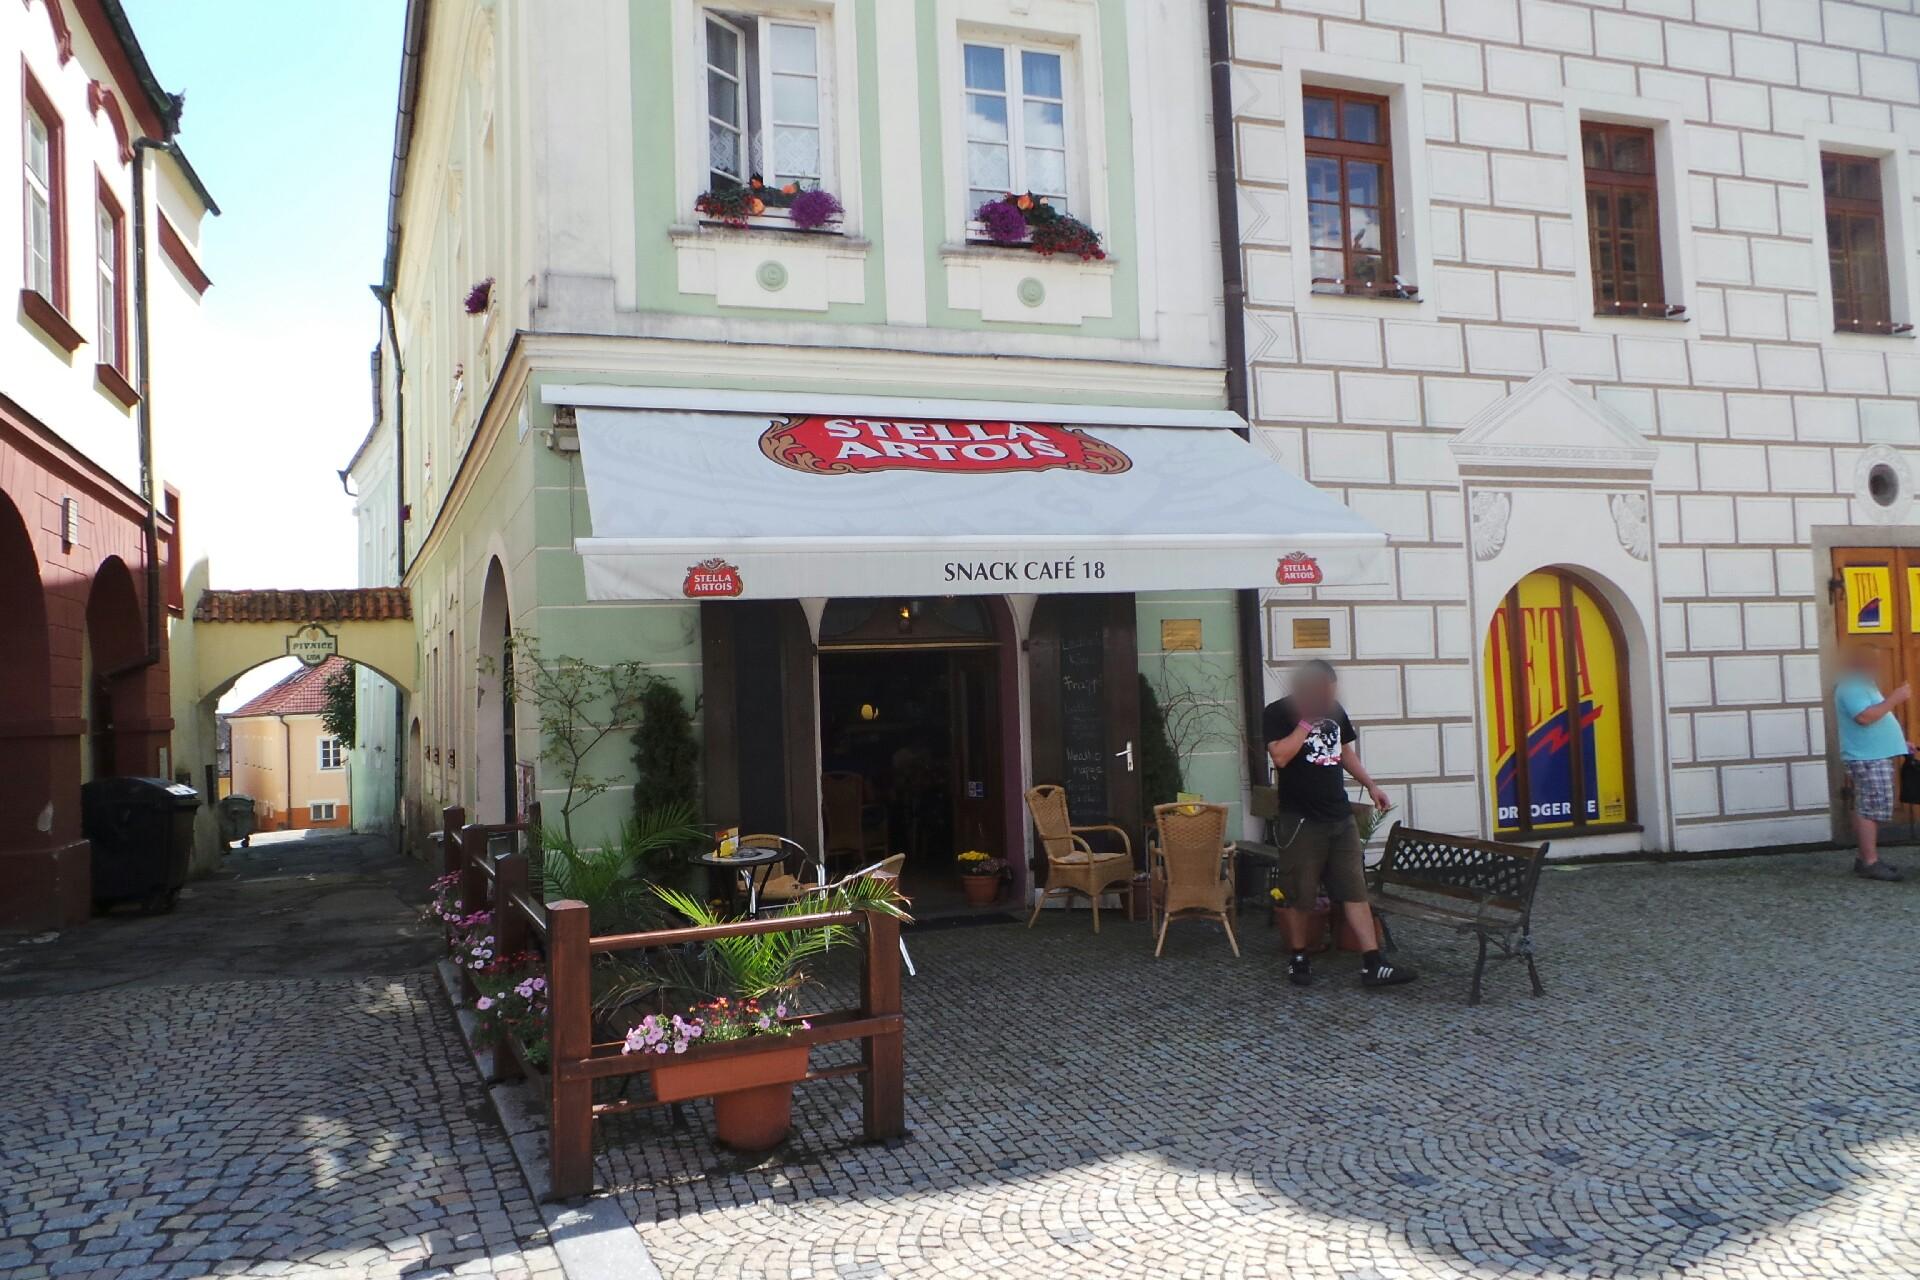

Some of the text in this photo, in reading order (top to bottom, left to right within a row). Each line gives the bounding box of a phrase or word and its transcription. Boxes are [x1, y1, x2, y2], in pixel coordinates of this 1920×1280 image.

[823, 418, 1050, 441] STELLA
[836, 439, 1067, 461] ARTOIS
[944, 555, 1105, 581] SNACK CAFÉ 18
[1284, 571, 1315, 579] ARTOIS
[694, 574, 732, 583] STELLA
[694, 582, 732, 592] ARTOIS
[292, 642, 333, 650] PIVNICE
[1499, 800, 1597, 820] DROGERE
